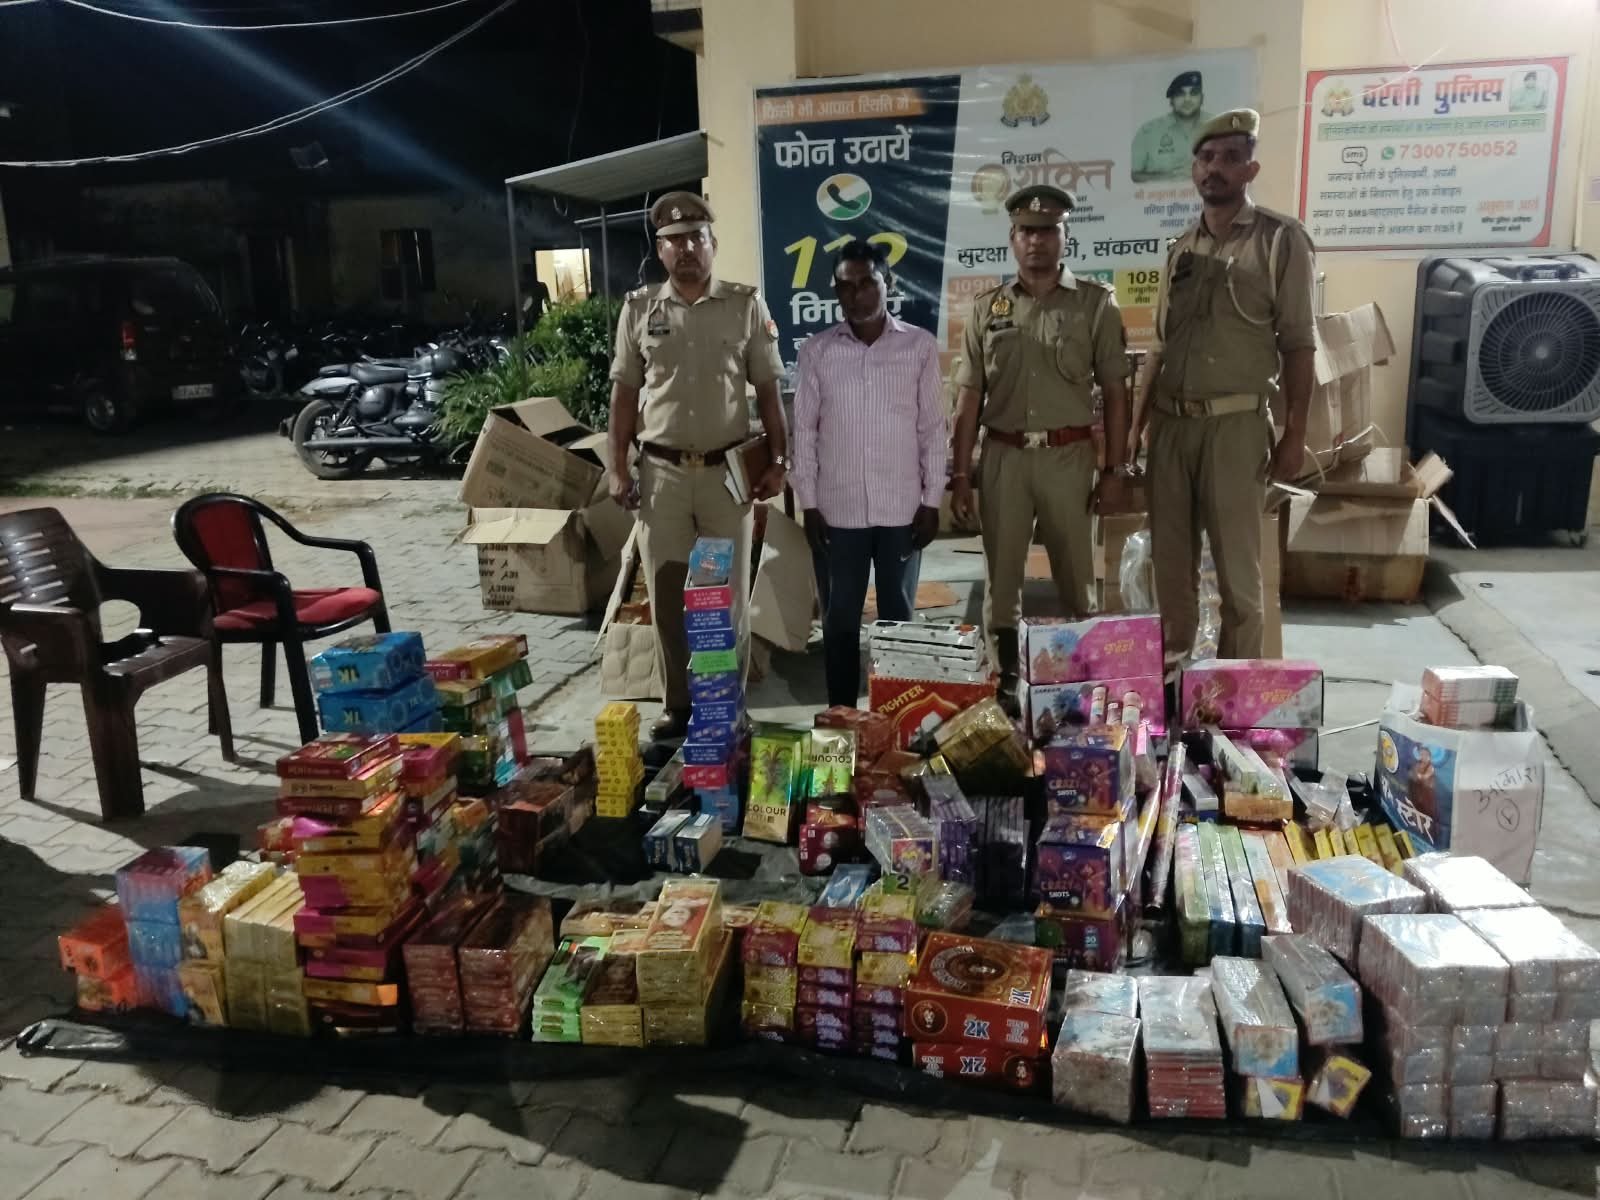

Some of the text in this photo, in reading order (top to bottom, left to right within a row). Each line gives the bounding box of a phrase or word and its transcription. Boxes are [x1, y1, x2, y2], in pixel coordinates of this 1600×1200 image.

[1434, 74, 1504, 114] पुलिस
[774, 124, 912, 169] फोन उठायें
[1400, 141, 1518, 160] 7300750052
[1001, 152, 1042, 166] मिशन
[957, 247, 1008, 268] सुरक्षा
[1093, 237, 1160, 258] संकल्प
[1127, 271, 1159, 284] 108
[877, 685, 926, 715] FIGHTER
[811, 754, 852, 764] COLOUR
[1057, 788, 1077, 796] SHOTS
[746, 804, 787, 817] COLOUR
[897, 875, 909, 891] 2
[963, 1018, 990, 1040] 2K
[960, 1056, 986, 1074] 2K
